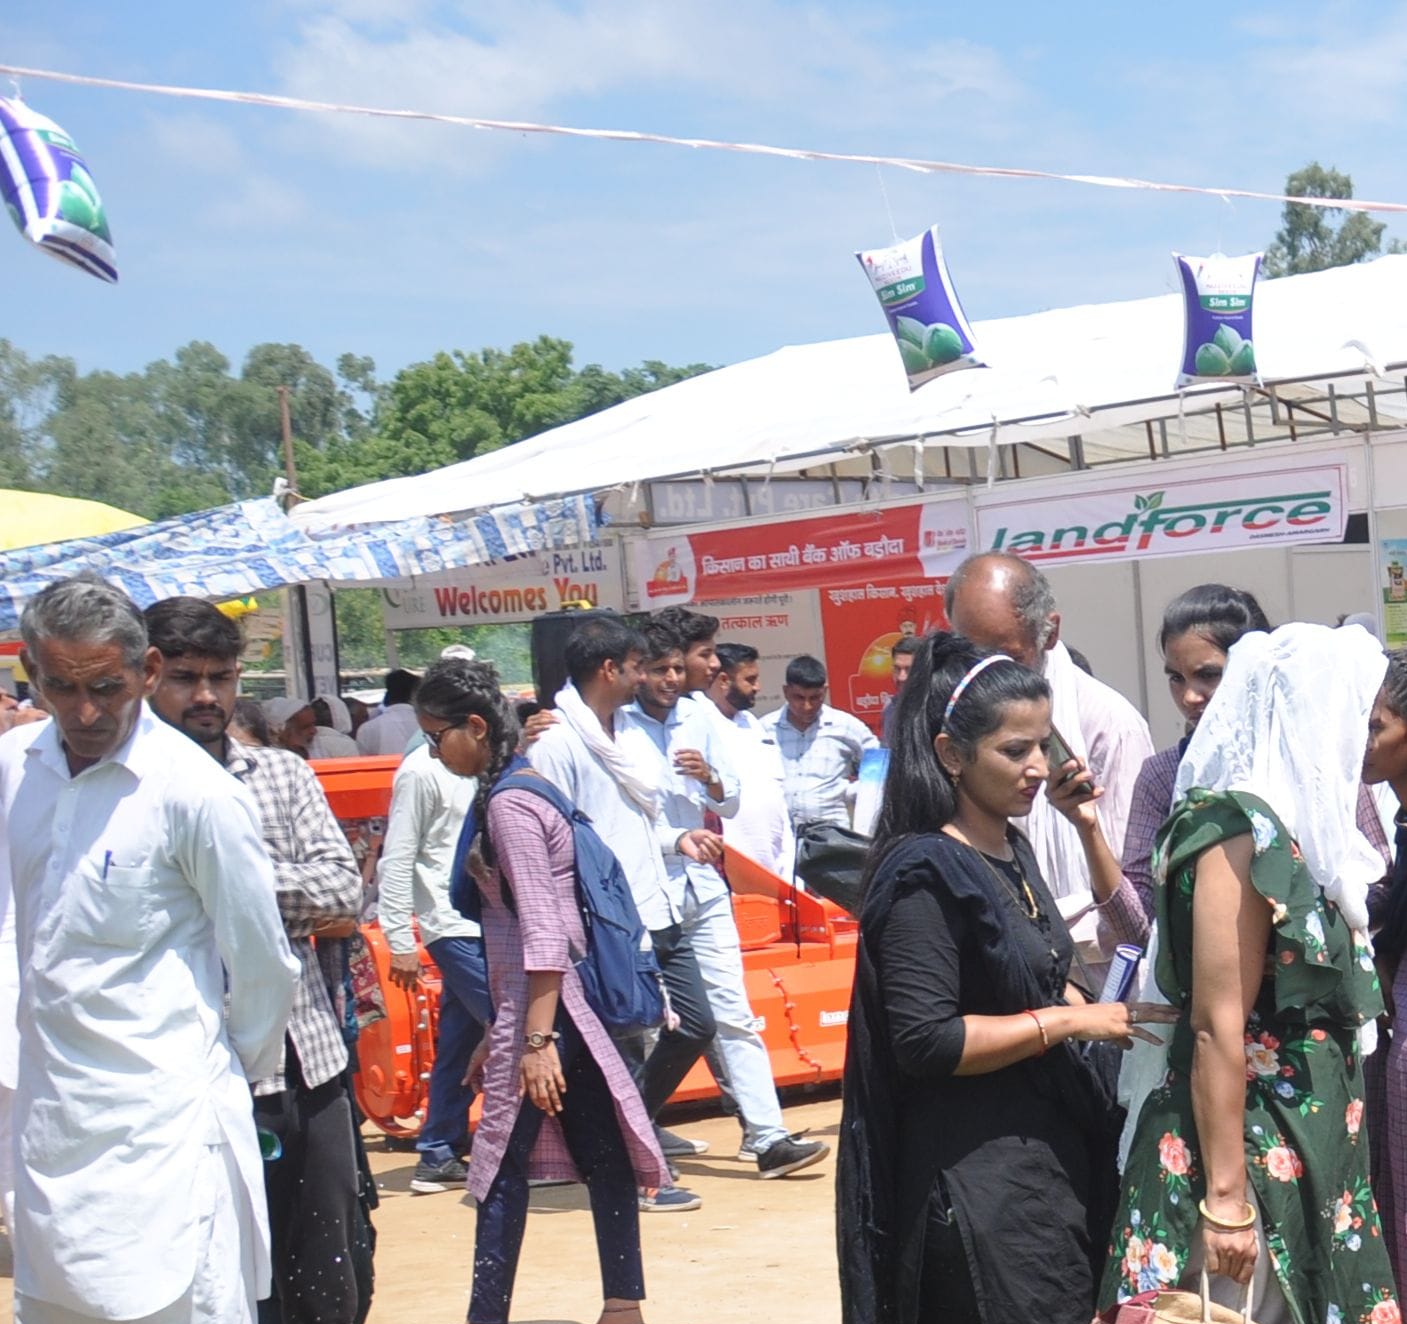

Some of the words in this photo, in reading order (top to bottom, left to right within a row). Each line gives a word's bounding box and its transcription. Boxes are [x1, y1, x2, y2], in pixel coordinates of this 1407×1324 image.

[896, 282, 916, 295] Sim
[990, 491, 1333, 551] landforce
[554, 553, 578, 574] Pvt.
[582, 551, 607, 573] Ltd.
[702, 555, 746, 576] किसान
[748, 554, 767, 571] का
[768, 544, 800, 568] साथी
[802, 544, 827, 564] बैंक
[830, 541, 862, 563] ऑफ
[864, 535, 905, 560] बड़ौदा
[434, 585, 547, 617] Welcomes
[554, 577, 597, 607] You
[720, 616, 762, 630] तत्काल
